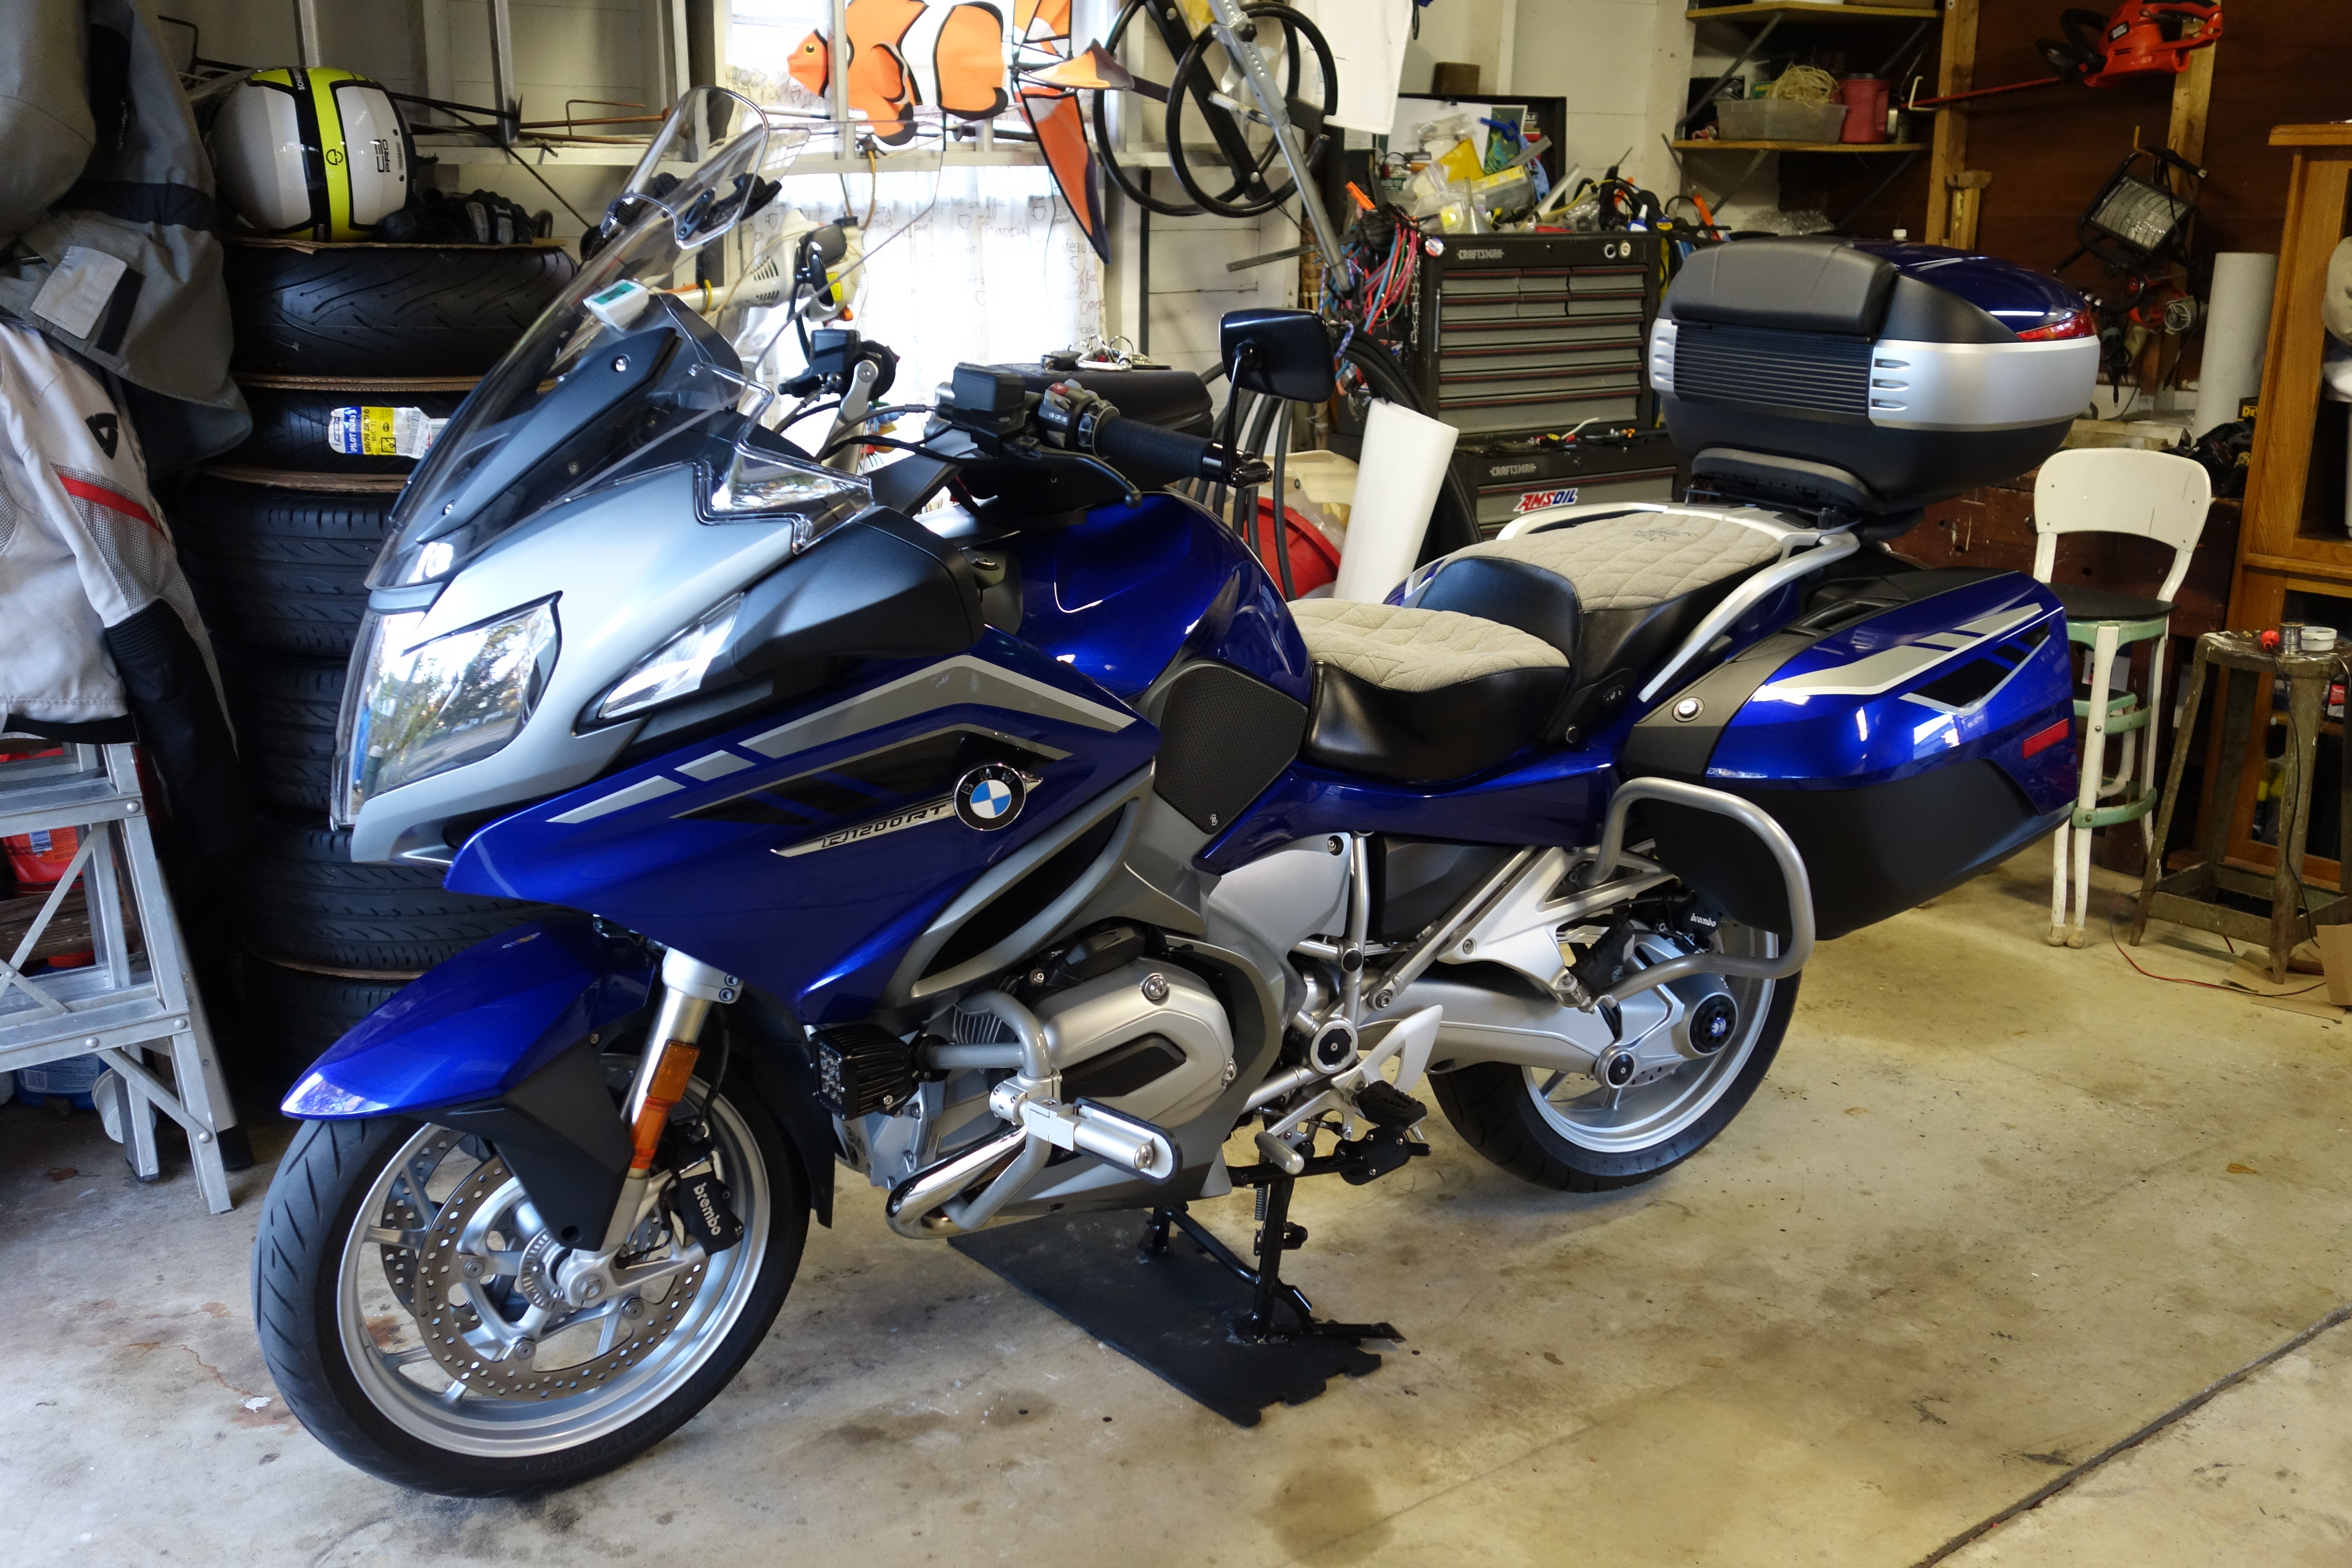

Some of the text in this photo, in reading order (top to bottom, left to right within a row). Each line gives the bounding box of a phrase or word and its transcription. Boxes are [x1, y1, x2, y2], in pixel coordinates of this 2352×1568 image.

[382, 139, 391, 173] PRO
[1458, 248, 1504, 260] CRAFTSMAN
[1491, 462, 1535, 477] CRAFTSMAN
[1517, 489, 1577, 511] AMSOIL
[960, 768, 1015, 795] BMW
[1690, 913, 1717, 927] brembo
[693, 1182, 721, 1236] brembo
